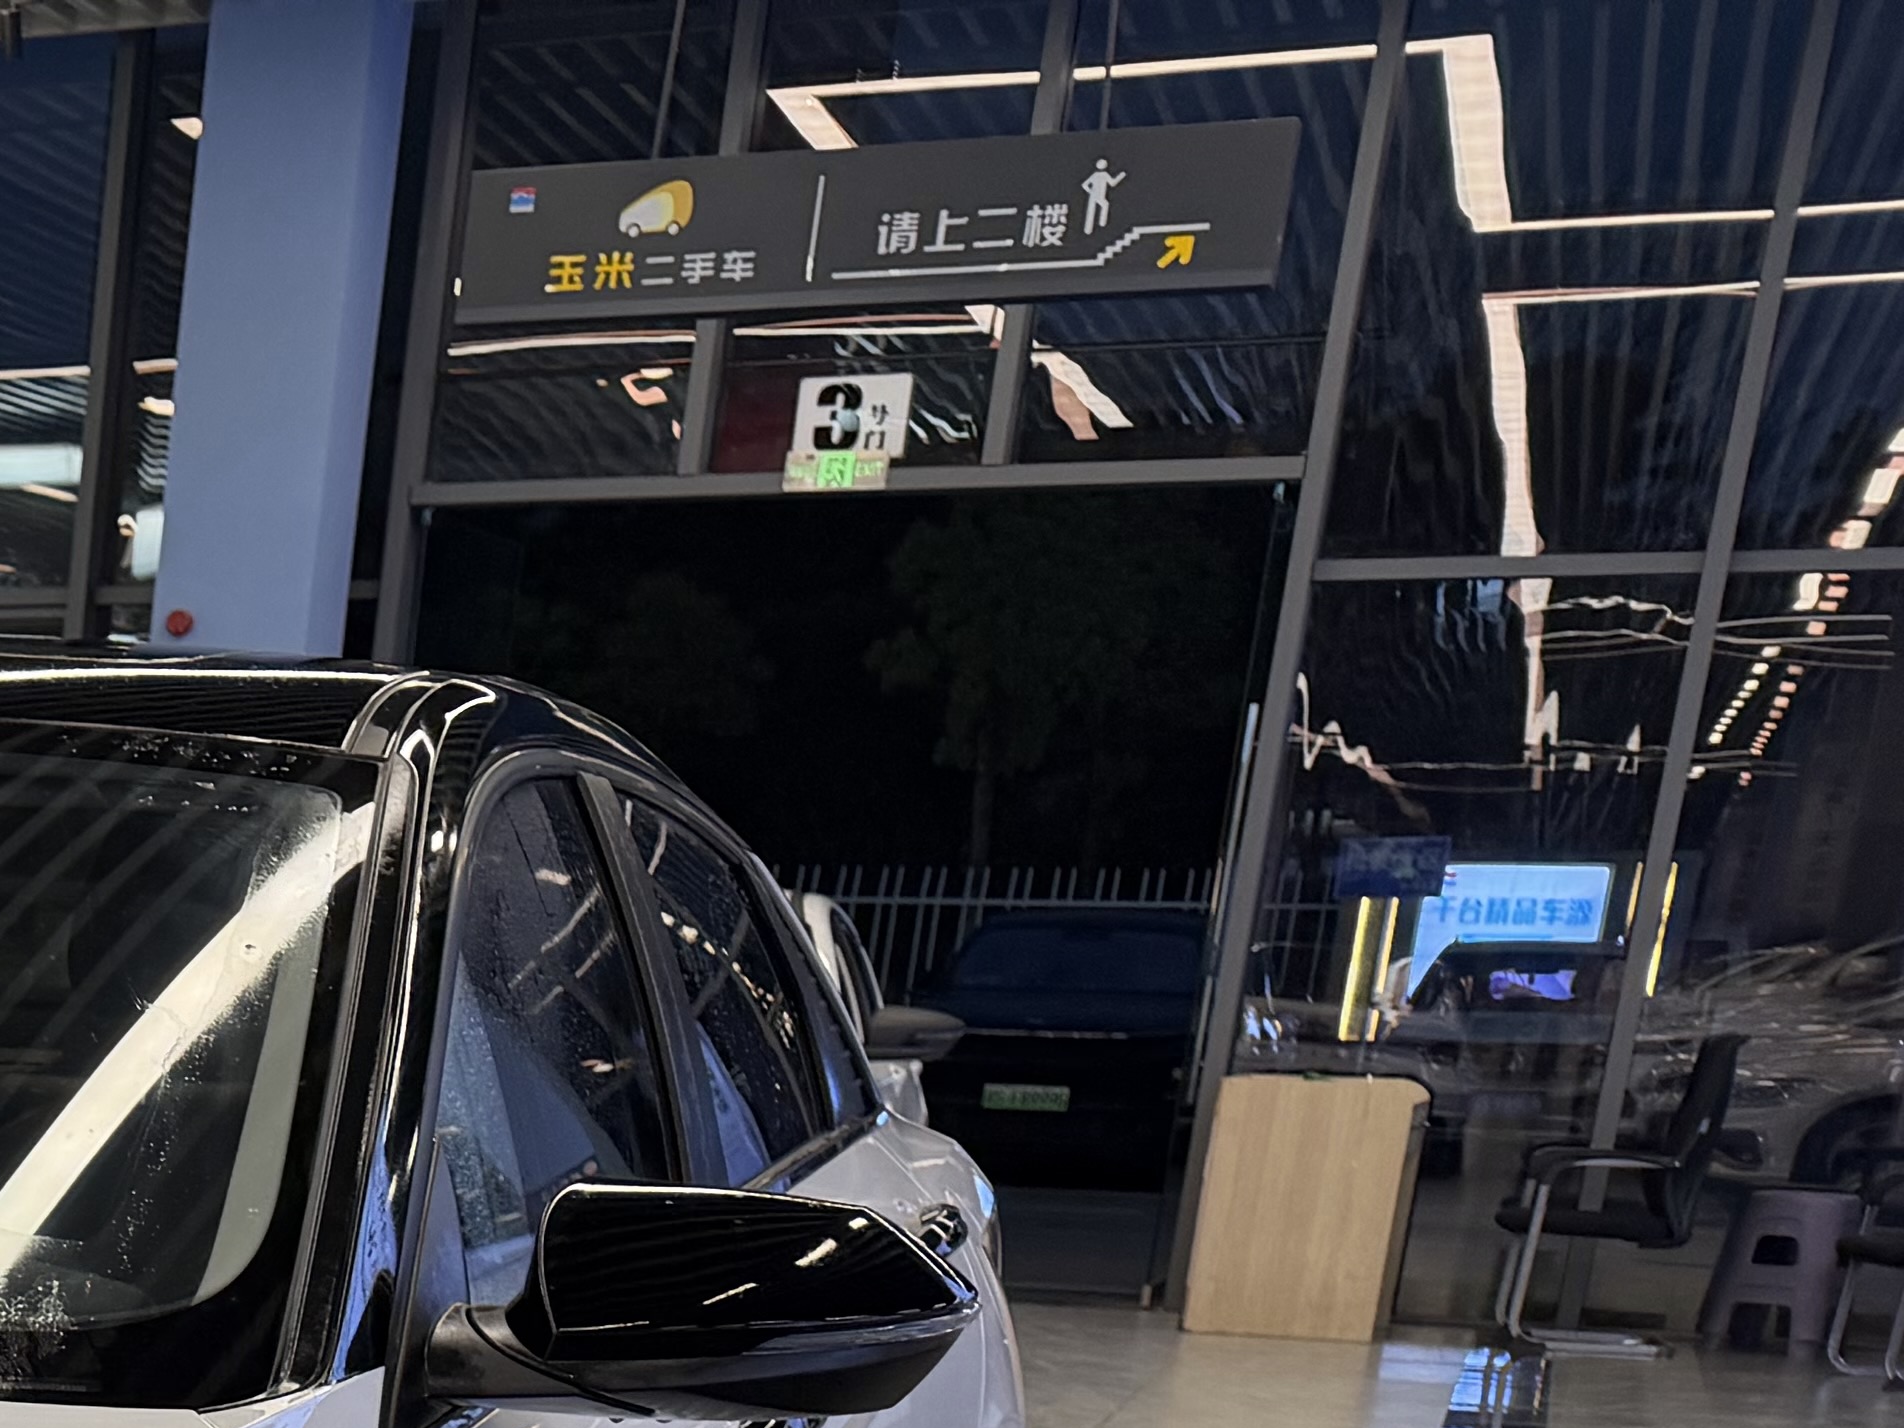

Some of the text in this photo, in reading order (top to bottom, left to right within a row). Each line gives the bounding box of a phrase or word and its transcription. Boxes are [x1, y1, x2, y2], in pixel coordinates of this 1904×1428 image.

[876, 203, 1069, 256] 请上二楼
[544, 250, 757, 293] 玉米二手车
